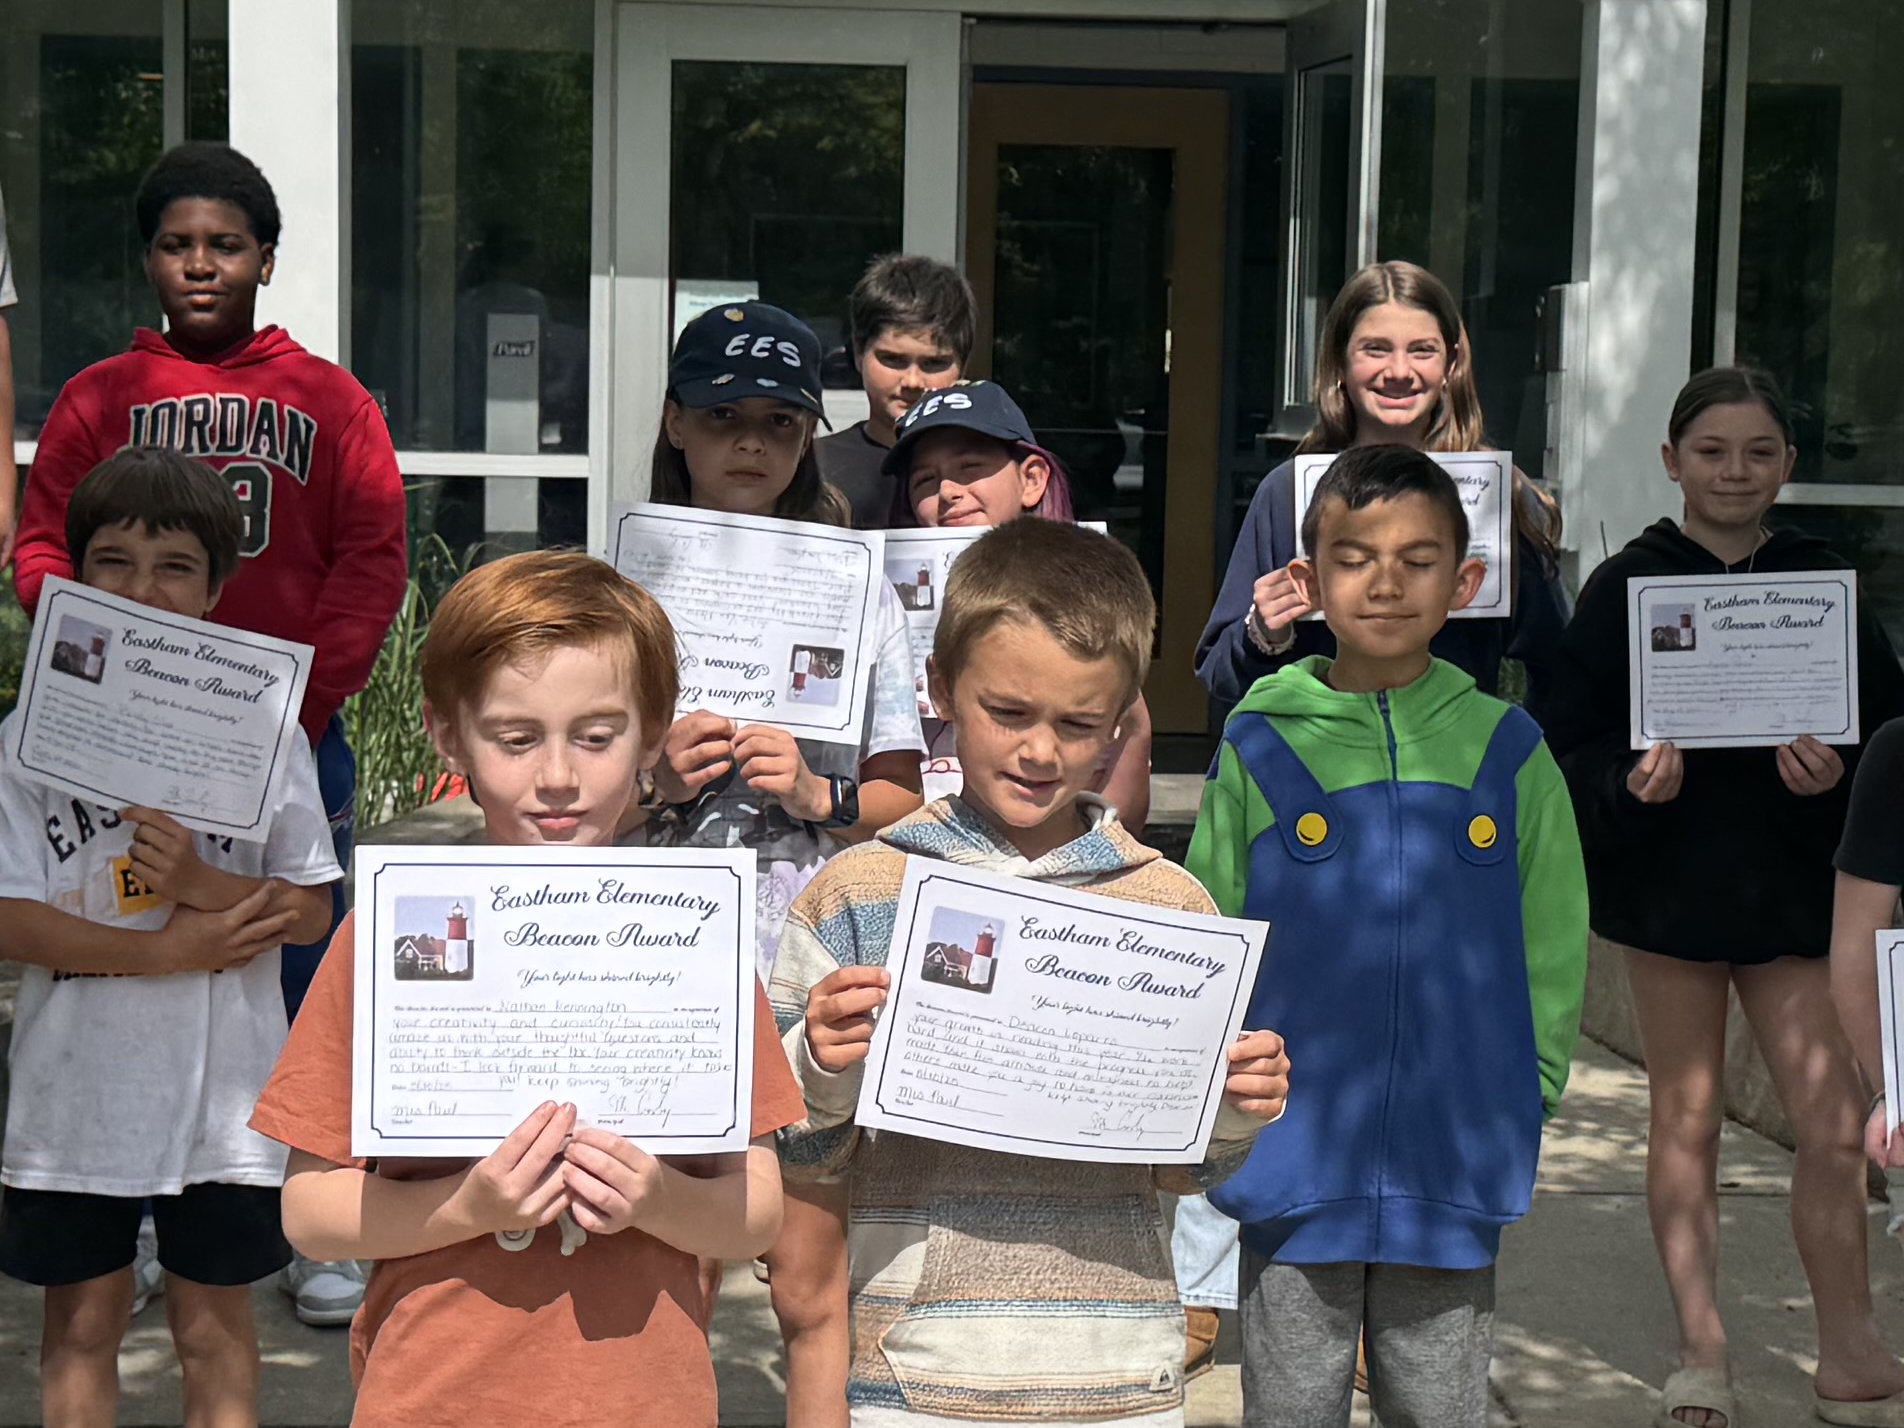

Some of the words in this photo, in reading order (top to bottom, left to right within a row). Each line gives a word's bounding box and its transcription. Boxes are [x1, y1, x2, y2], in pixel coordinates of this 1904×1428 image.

[725, 333, 802, 368] EES
[131, 393, 318, 486] JORDAN
[122, 628, 189, 656] Eastham
[194, 642, 278, 687] Elementary
[705, 658, 769, 680] Beacon
[125, 659, 189, 686] Beacon
[195, 678, 263, 703] Award
[709, 689, 775, 707] Eastham
[491, 884, 590, 911] Eastham
[597, 879, 720, 921] Elementary
[504, 923, 599, 946] Beacon
[606, 923, 701, 947] Award
[1020, 916, 1109, 947] Eastham
[1116, 928, 1225, 978] Elementary
[518, 970, 549, 988] Your
[553, 971, 576, 985] light
[578, 971, 597, 981] has
[1025, 955, 1111, 986] Beacon
[1118, 972, 1204, 998] Award
[1032, 996, 1059, 1010] Your
[1062, 1002, 1083, 1014] light
[1085, 1006, 1102, 1016] has
[510, 1018, 538, 1028] and
[669, 1032, 697, 1043] and
